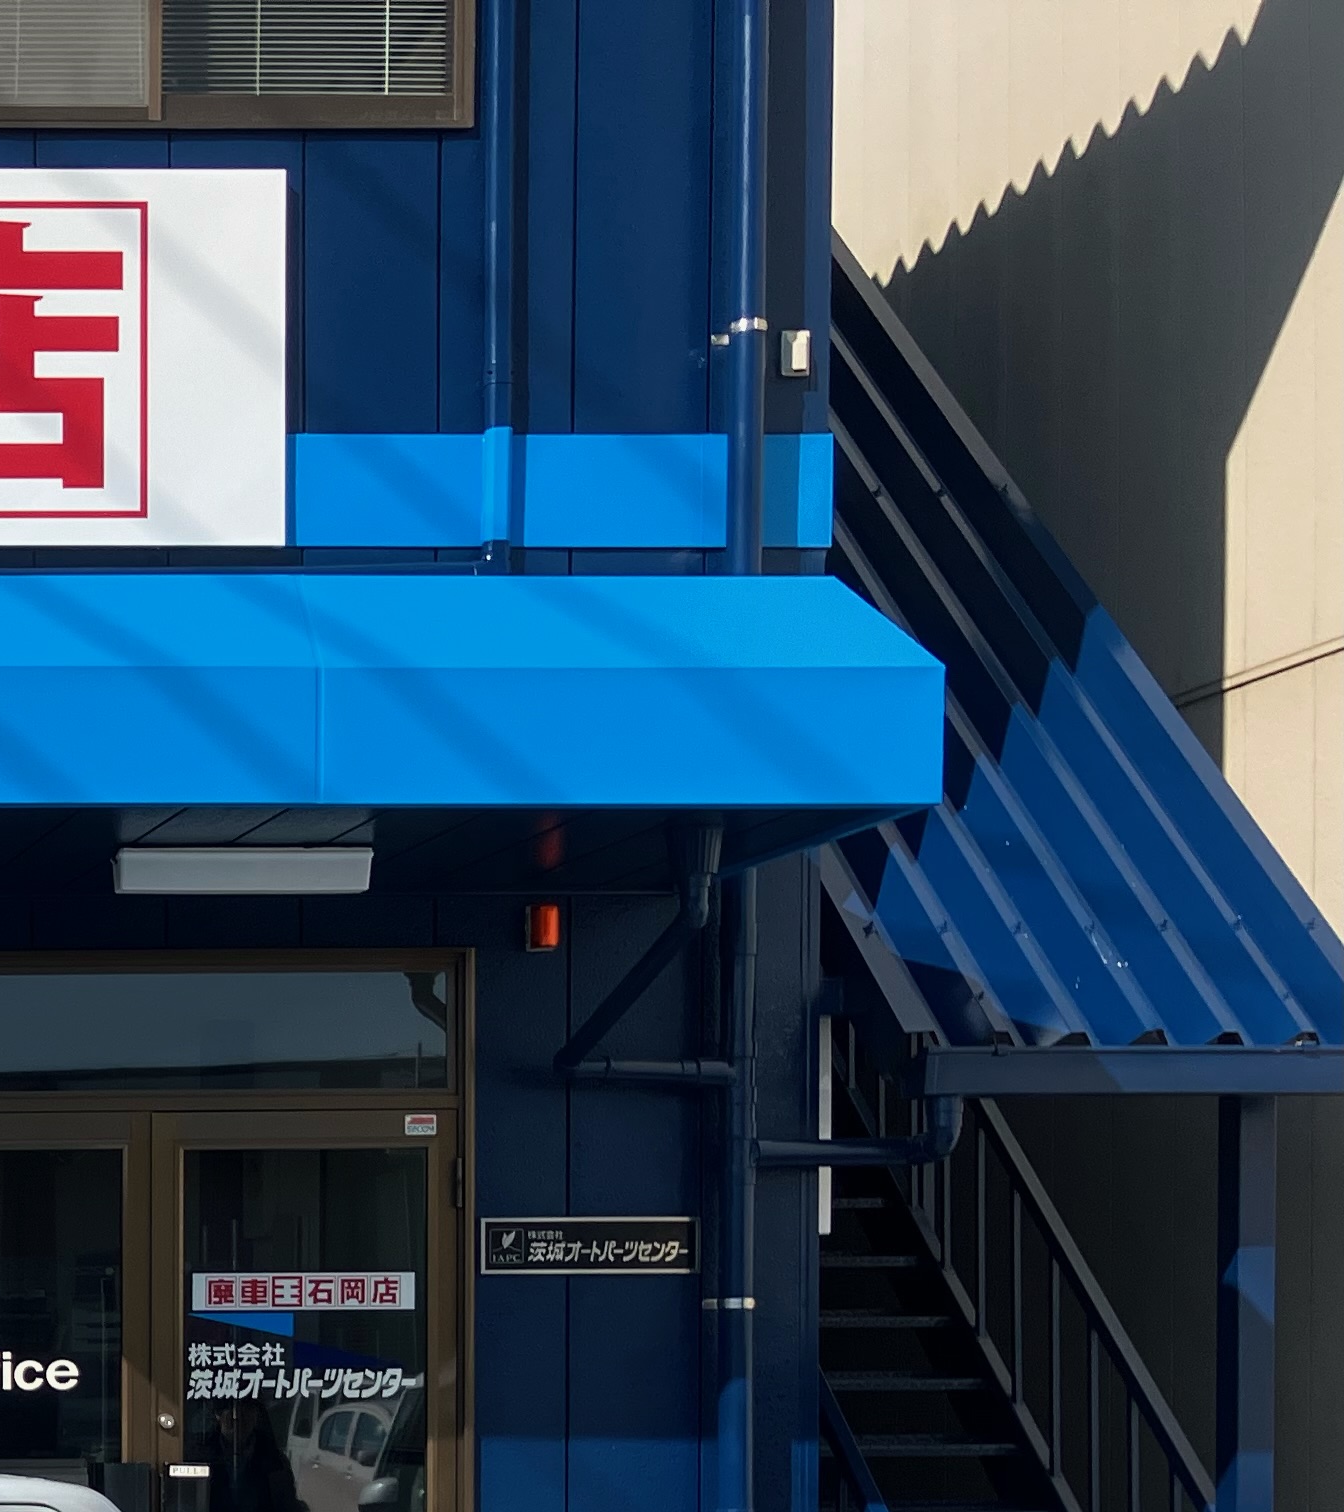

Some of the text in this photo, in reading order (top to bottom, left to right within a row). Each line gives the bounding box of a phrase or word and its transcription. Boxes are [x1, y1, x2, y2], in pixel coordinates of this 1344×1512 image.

[528, 1241, 688, 1263] 茨城オートパーツセンター
[188, 1343, 285, 1367] 株式会社
[187, 1368, 417, 1400] 茨城オートパーツセンター
